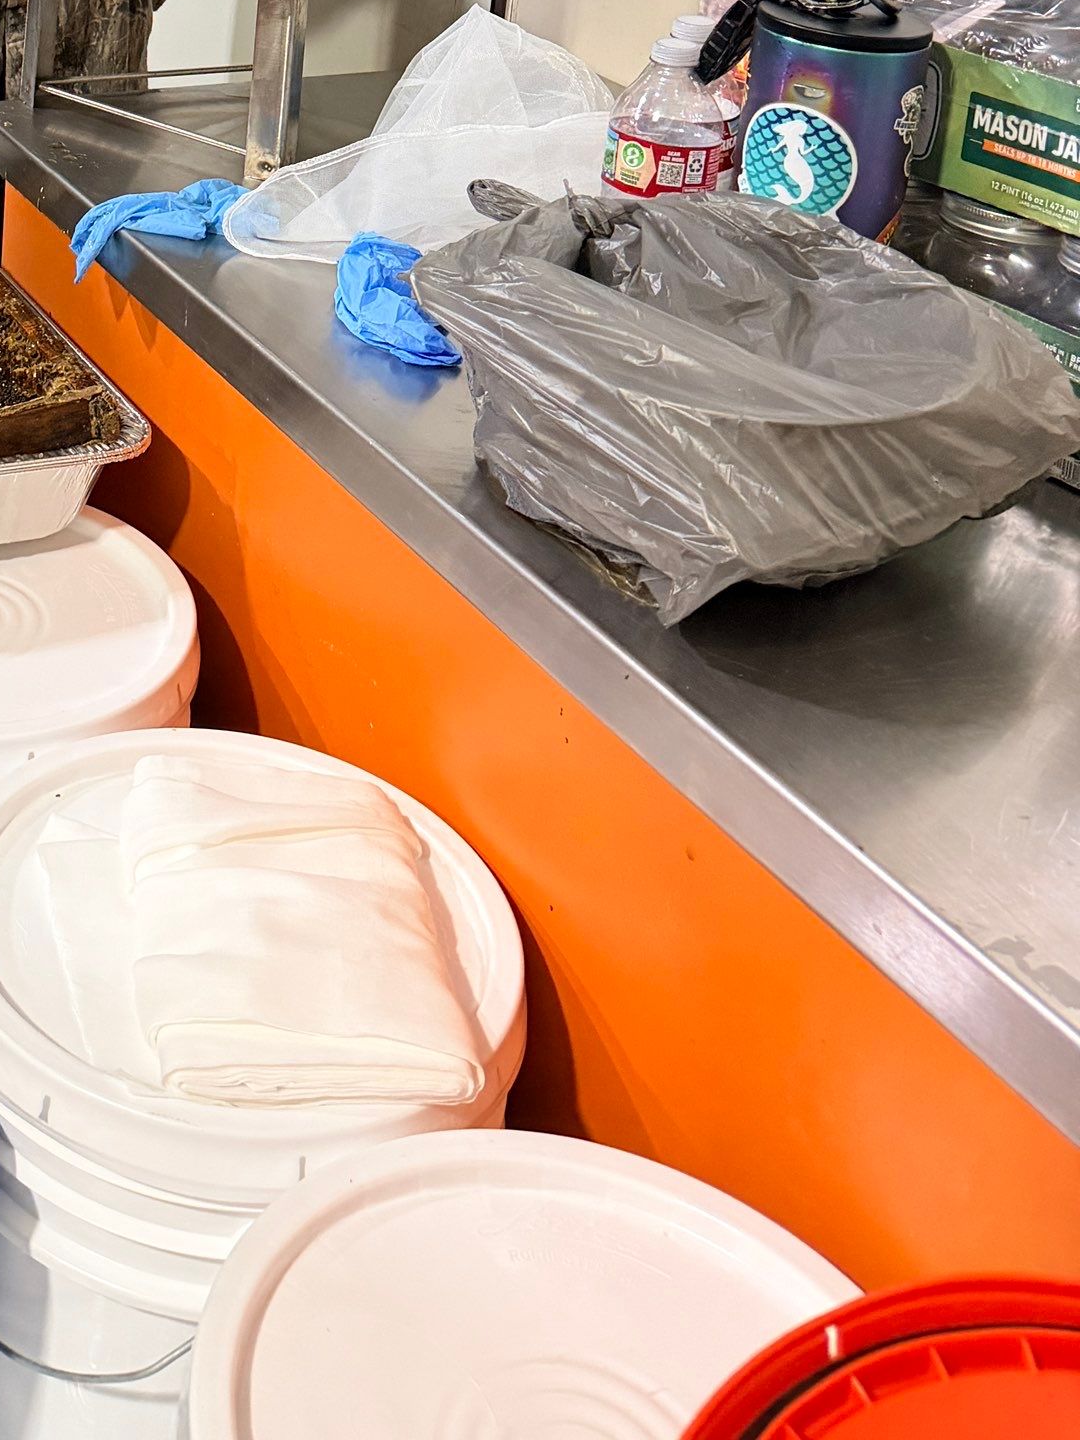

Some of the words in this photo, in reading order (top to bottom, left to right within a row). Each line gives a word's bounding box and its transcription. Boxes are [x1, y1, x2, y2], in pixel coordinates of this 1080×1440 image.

[972, 104, 1048, 152] MASON
[1052, 131, 1080, 164] JA
[994, 143, 1015, 157] SEALS
[1048, 160, 1077, 179] MONTHS
[991, 180, 999, 190] 12
[1000, 184, 1020, 197] PINT
[1033, 197, 1044, 206] oz
[1049, 200, 1065, 213] 473
